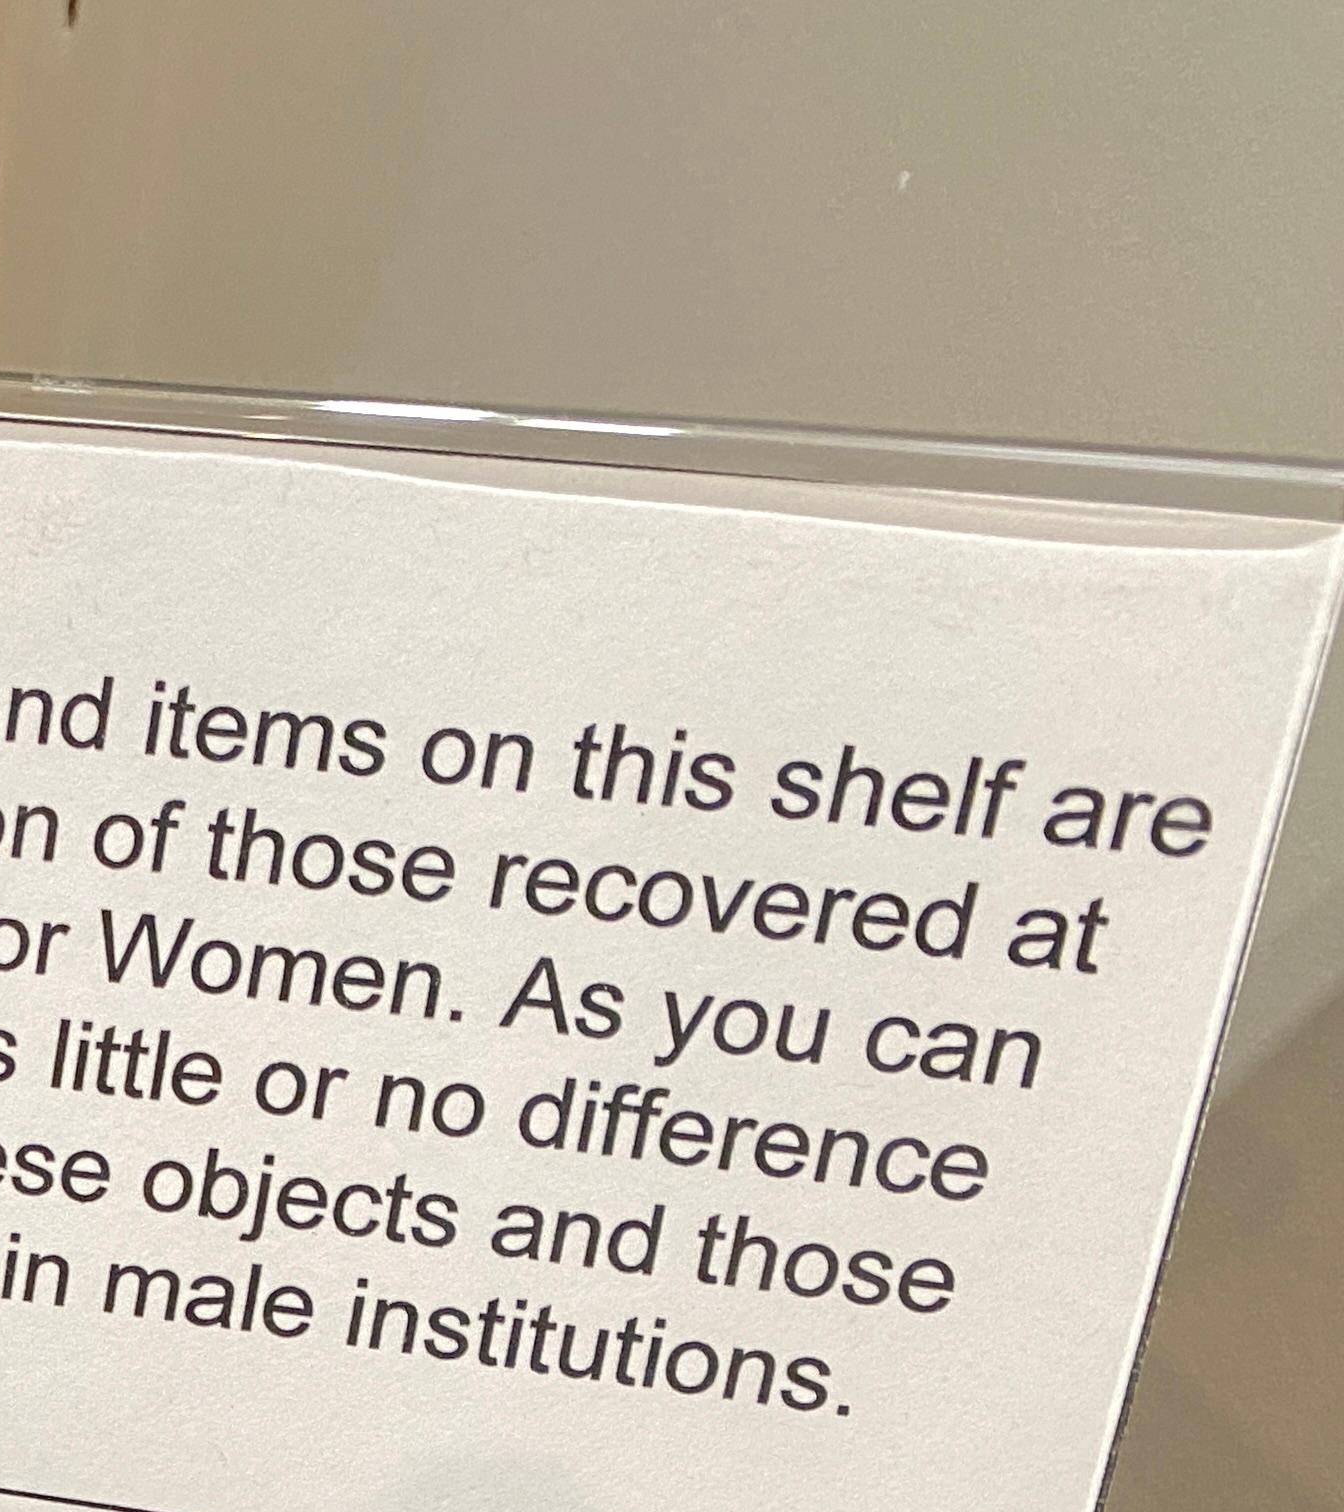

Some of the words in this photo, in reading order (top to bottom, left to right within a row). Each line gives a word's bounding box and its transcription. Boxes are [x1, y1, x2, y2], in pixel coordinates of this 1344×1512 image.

[144, 679, 387, 778] items
[420, 727, 535, 793] on
[572, 722, 736, 812] this
[770, 744, 1027, 839] shelf
[1042, 786, 1212, 858] are
[93, 798, 187, 873] of
[207, 806, 456, 903] those
[489, 853, 980, 960] recovered
[1006, 897, 1110, 975] at
[100, 908, 463, 1022] Women.
[498, 956, 625, 1040] As
[653, 990, 831, 1068] you
[865, 1015, 1042, 1090] can
[50, 1017, 223, 1107] little
[254, 1060, 350, 1121] or
[374, 1074, 486, 1138] no
[518, 1076, 989, 1202] difference
[142, 1146, 459, 1248] objects
[490, 1203, 666, 1276] and
[696, 1214, 955, 1314] those
[0, 1231, 70, 1307] in
[102, 1262, 314, 1339] male
[345, 1276, 850, 1417] institutions.
